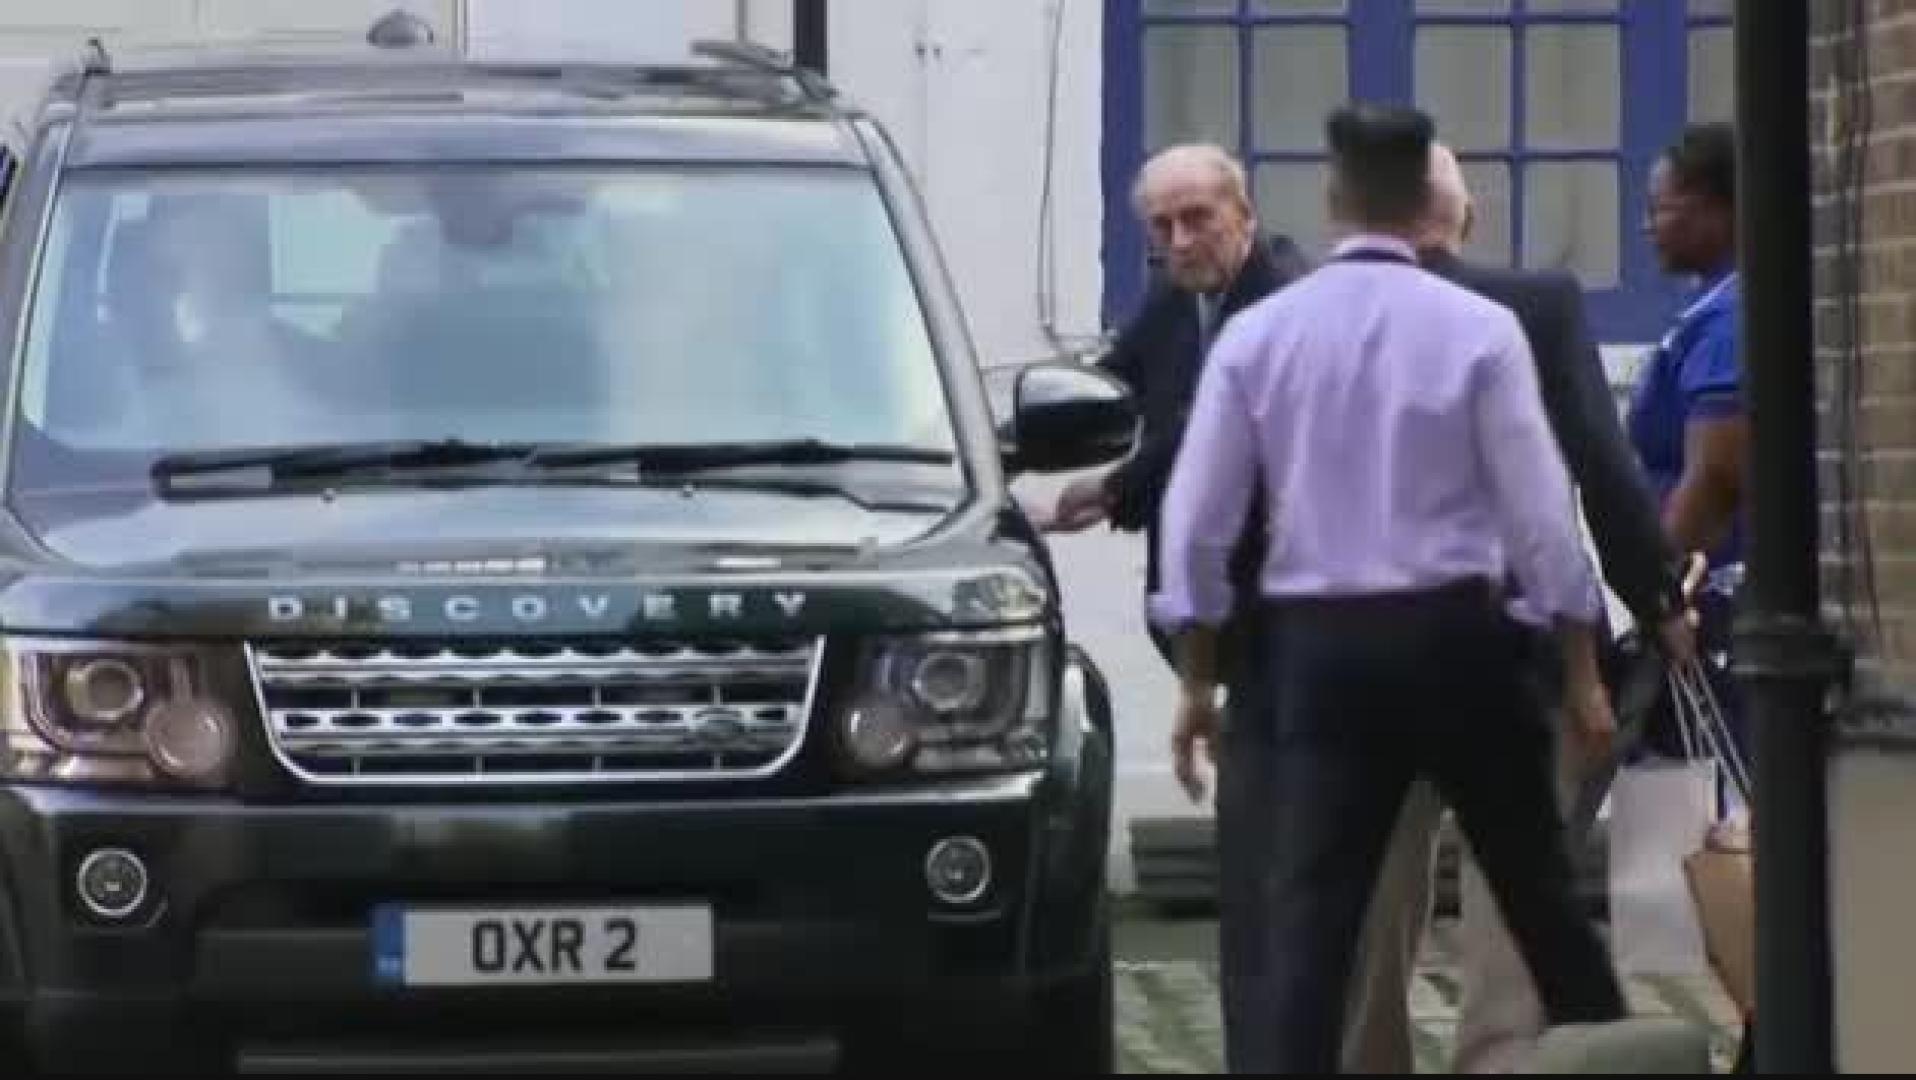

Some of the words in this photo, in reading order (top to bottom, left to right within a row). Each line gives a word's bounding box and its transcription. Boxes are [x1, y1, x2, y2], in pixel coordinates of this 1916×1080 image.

[267, 592, 807, 621] DISCOVERY
[471, 918, 586, 973] OXR
[603, 917, 638, 972] 2
